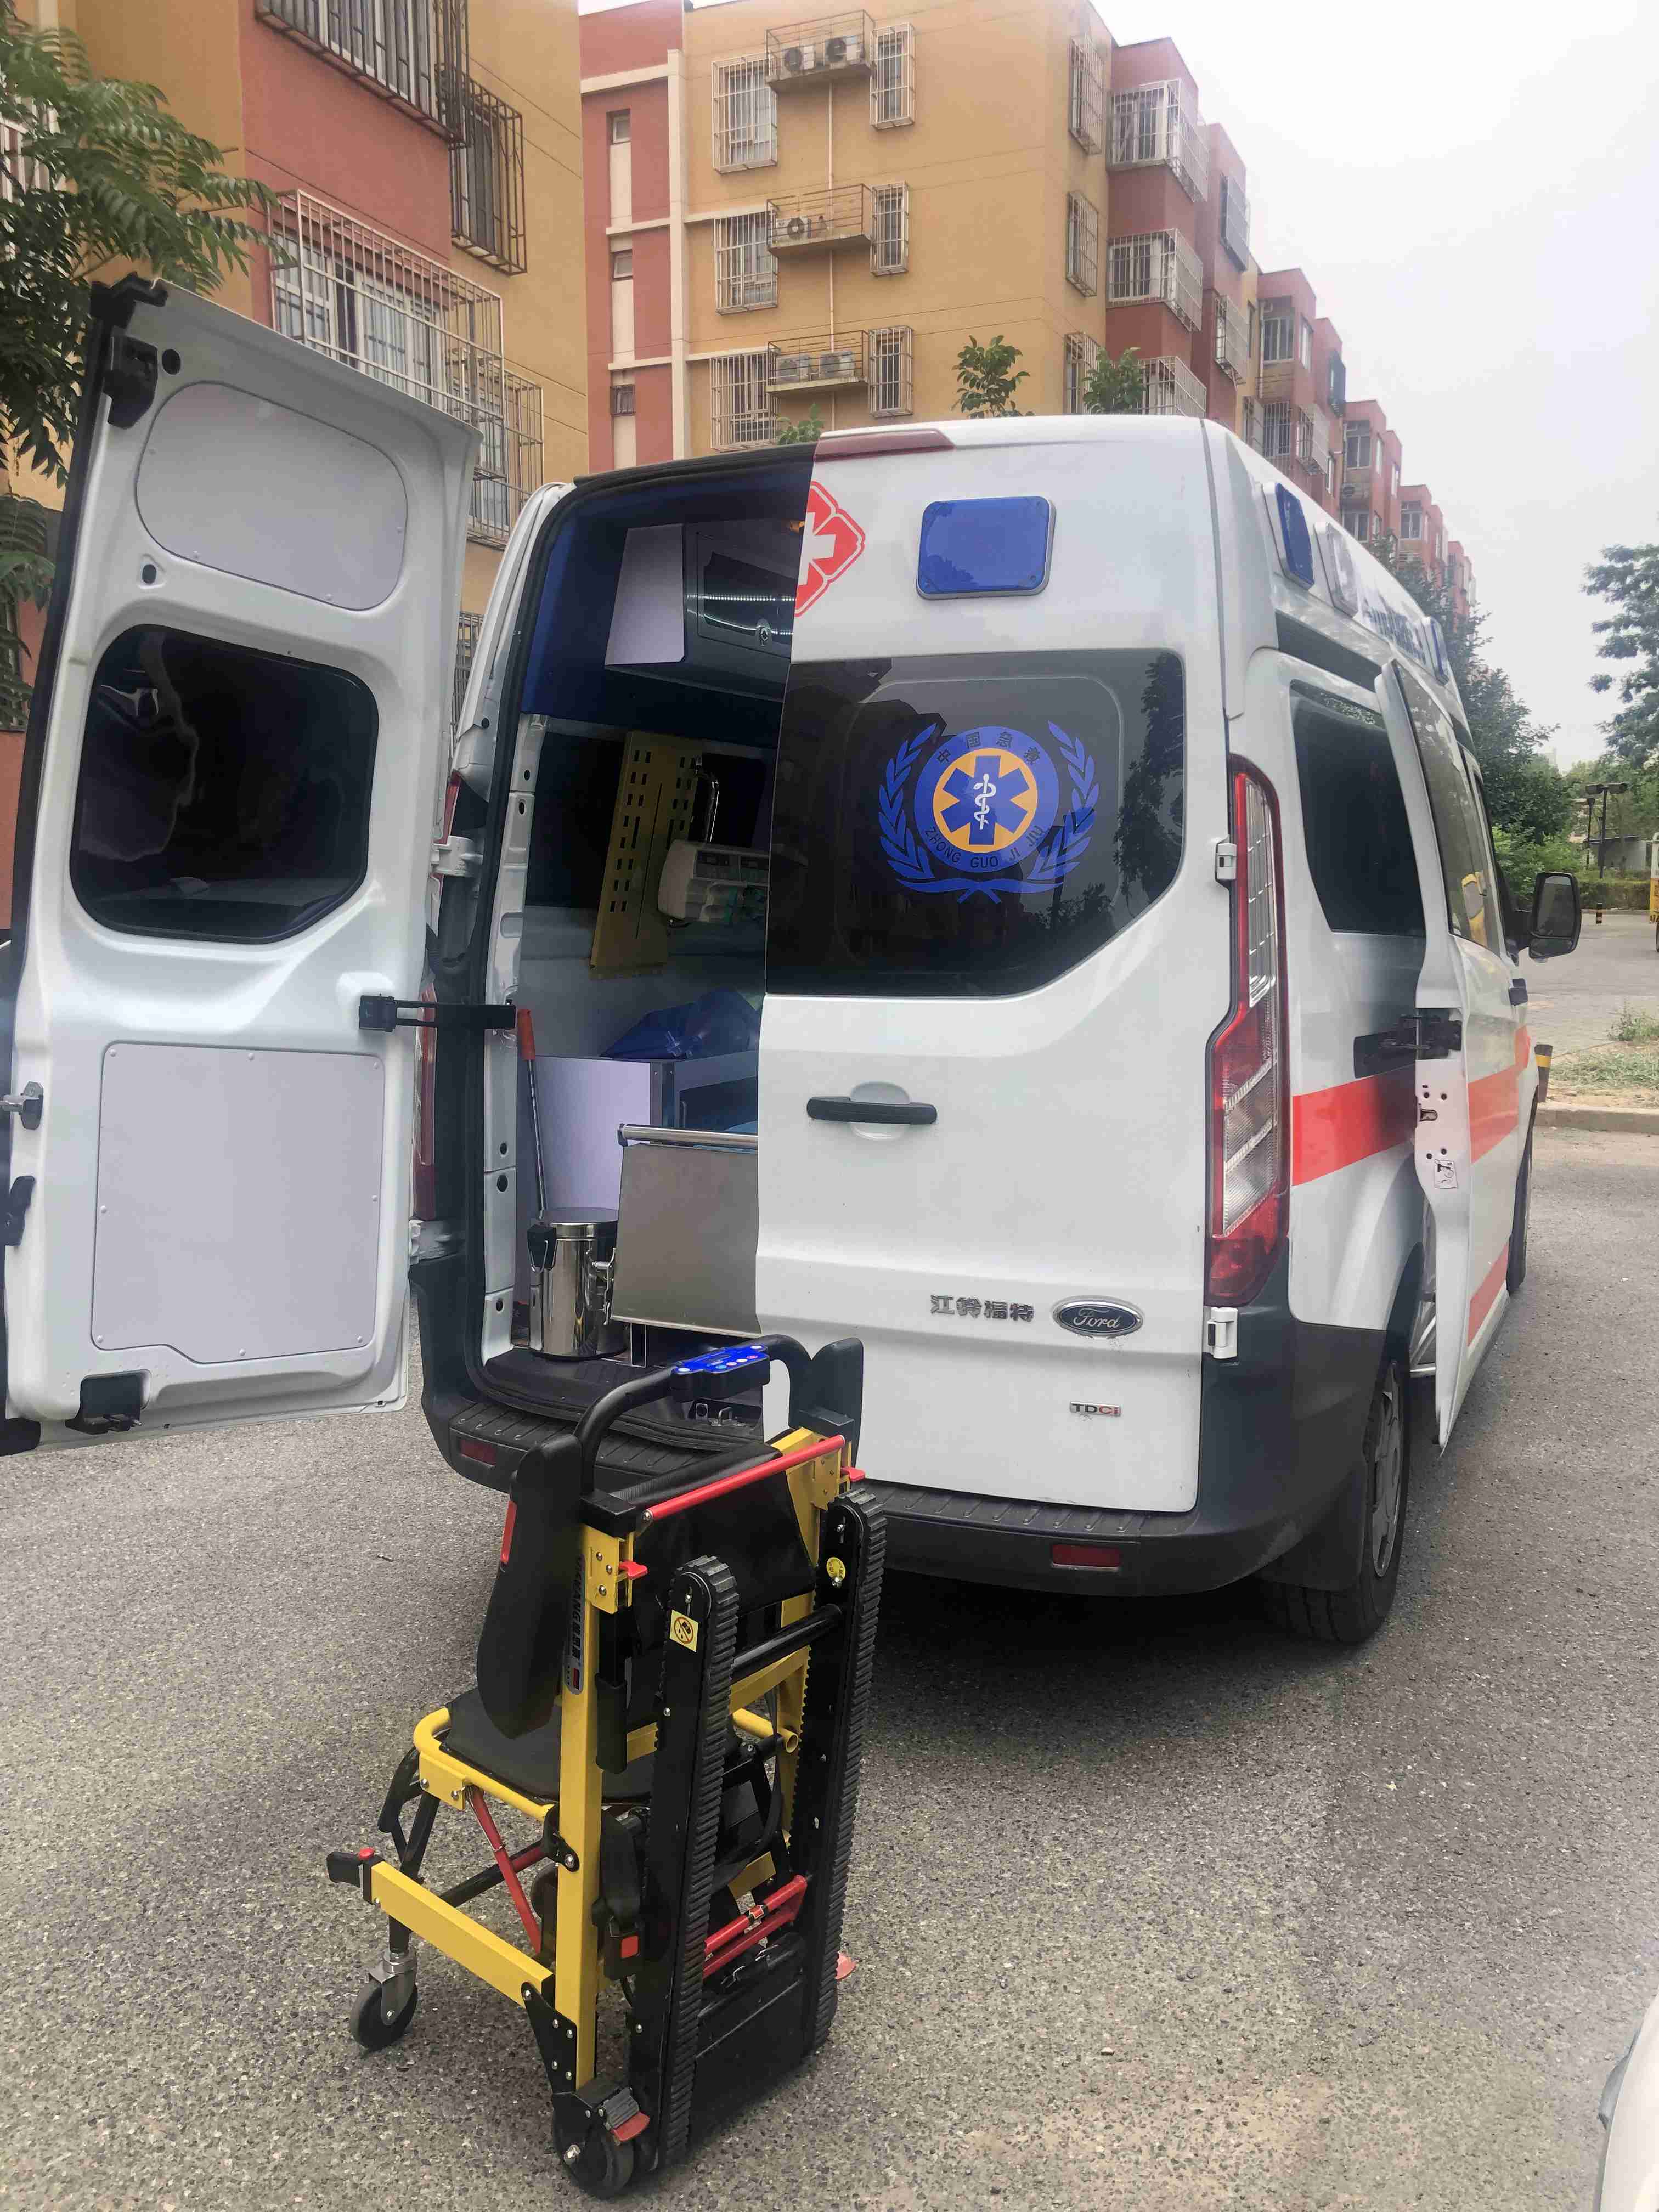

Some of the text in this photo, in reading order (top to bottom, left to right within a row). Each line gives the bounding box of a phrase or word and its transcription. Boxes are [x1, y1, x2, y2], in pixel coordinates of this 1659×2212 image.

[926, 825, 1045, 868] ZHONG GUO JI JIU
[930, 1294, 1035, 1322] 江铃福特
[1073, 1307, 1121, 1329] Ford
